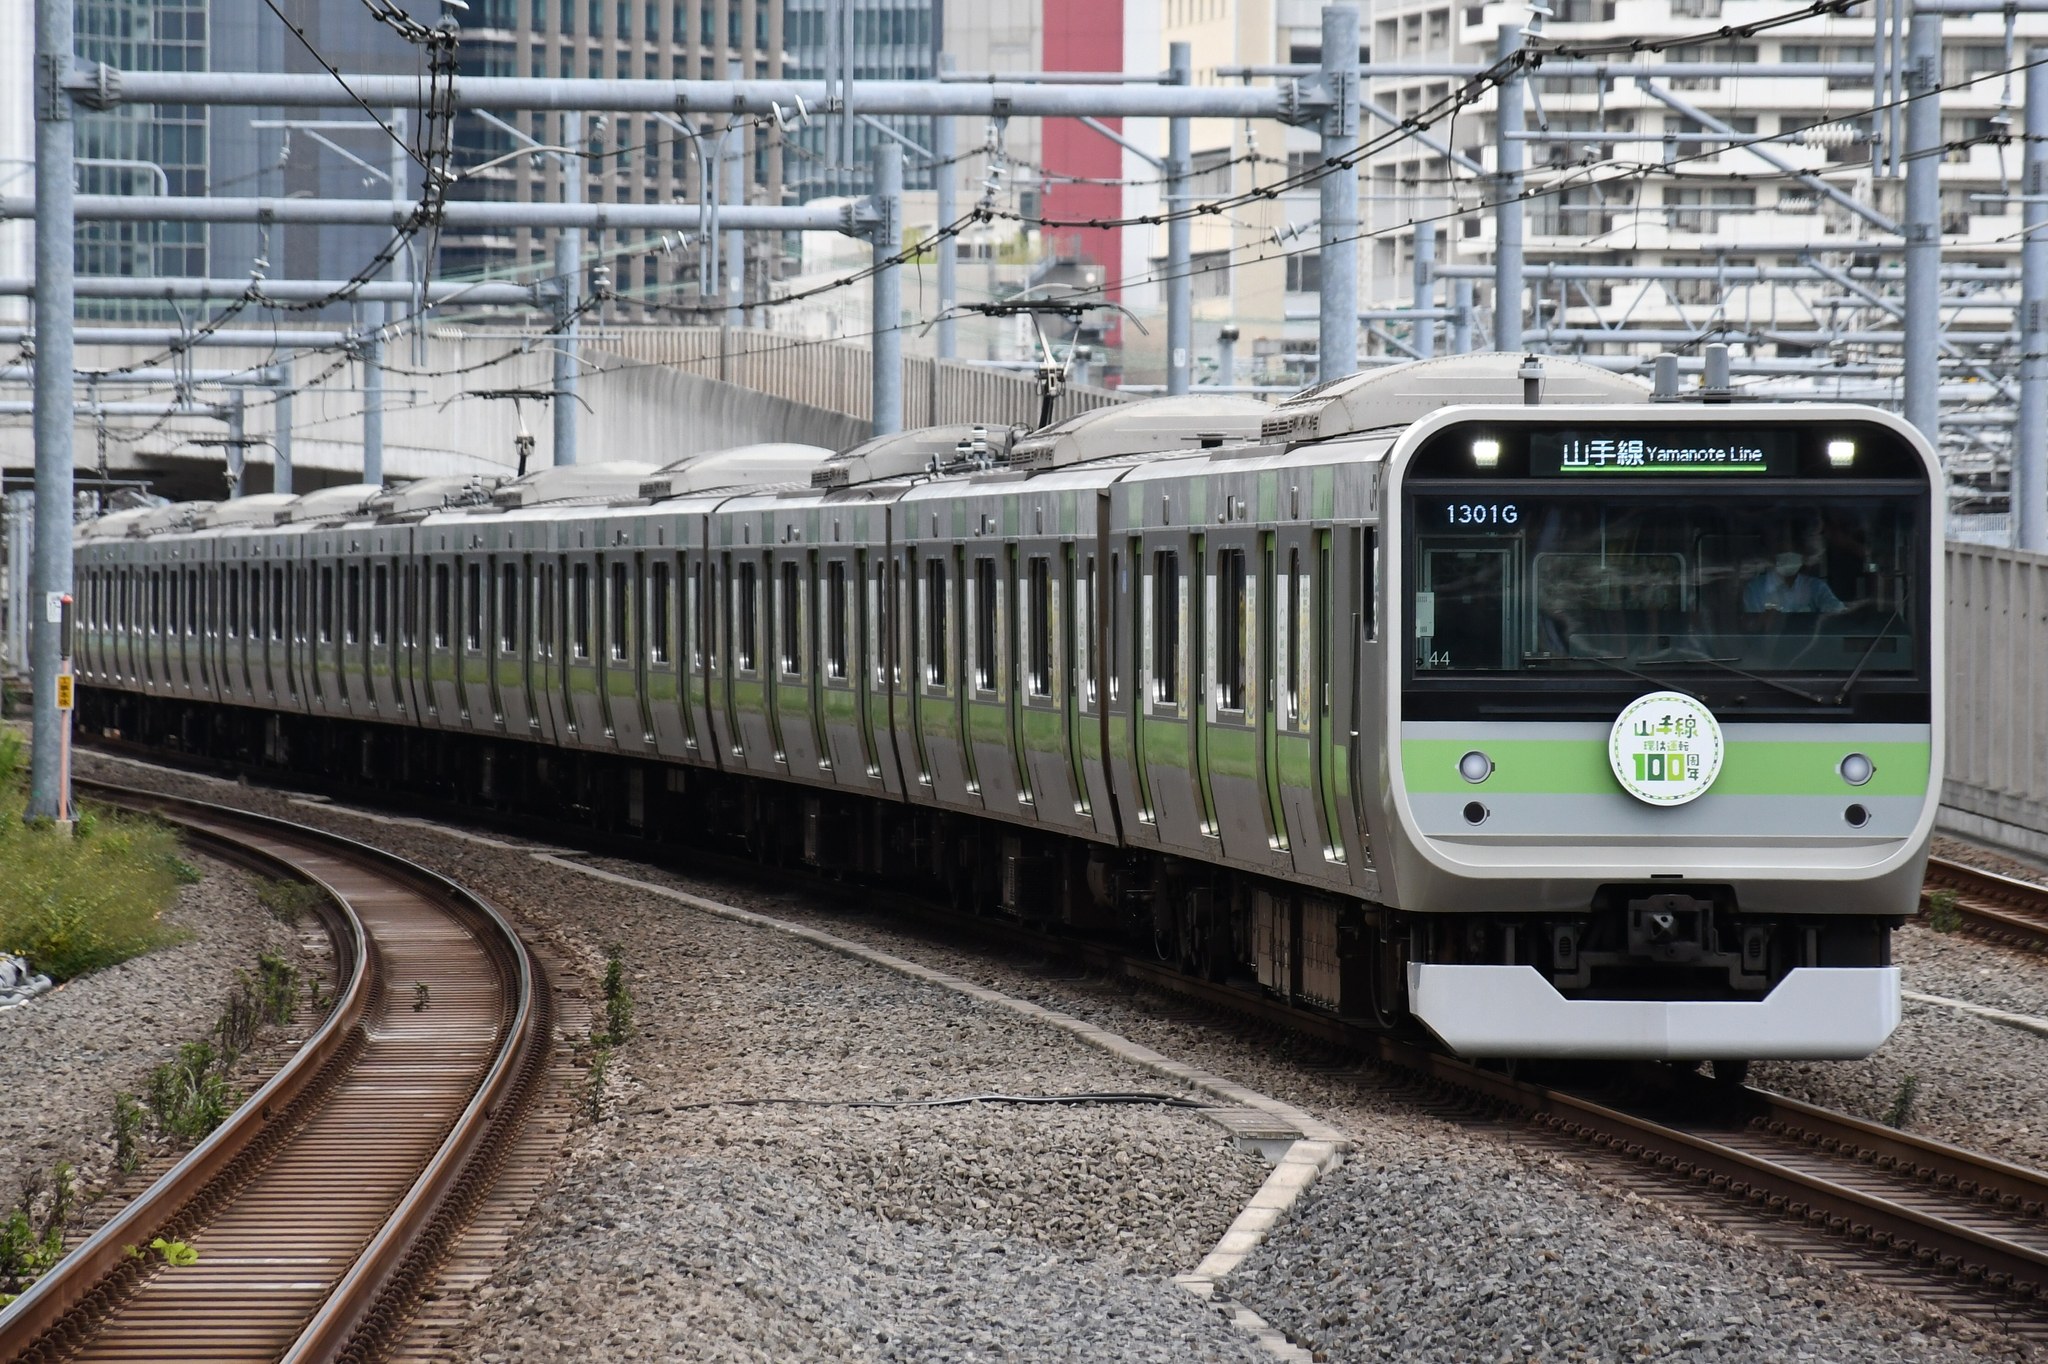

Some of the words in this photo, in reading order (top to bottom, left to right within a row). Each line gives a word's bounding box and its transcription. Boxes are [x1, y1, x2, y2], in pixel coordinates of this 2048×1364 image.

[1563, 440, 1645, 466] 山手線
[1646, 446, 1726, 462] Yamanote
[1730, 446, 1763, 462] Line
[1446, 504, 1518, 523] 1301G
[1428, 650, 1451, 666] 44
[1634, 713, 1699, 739] 山手線
